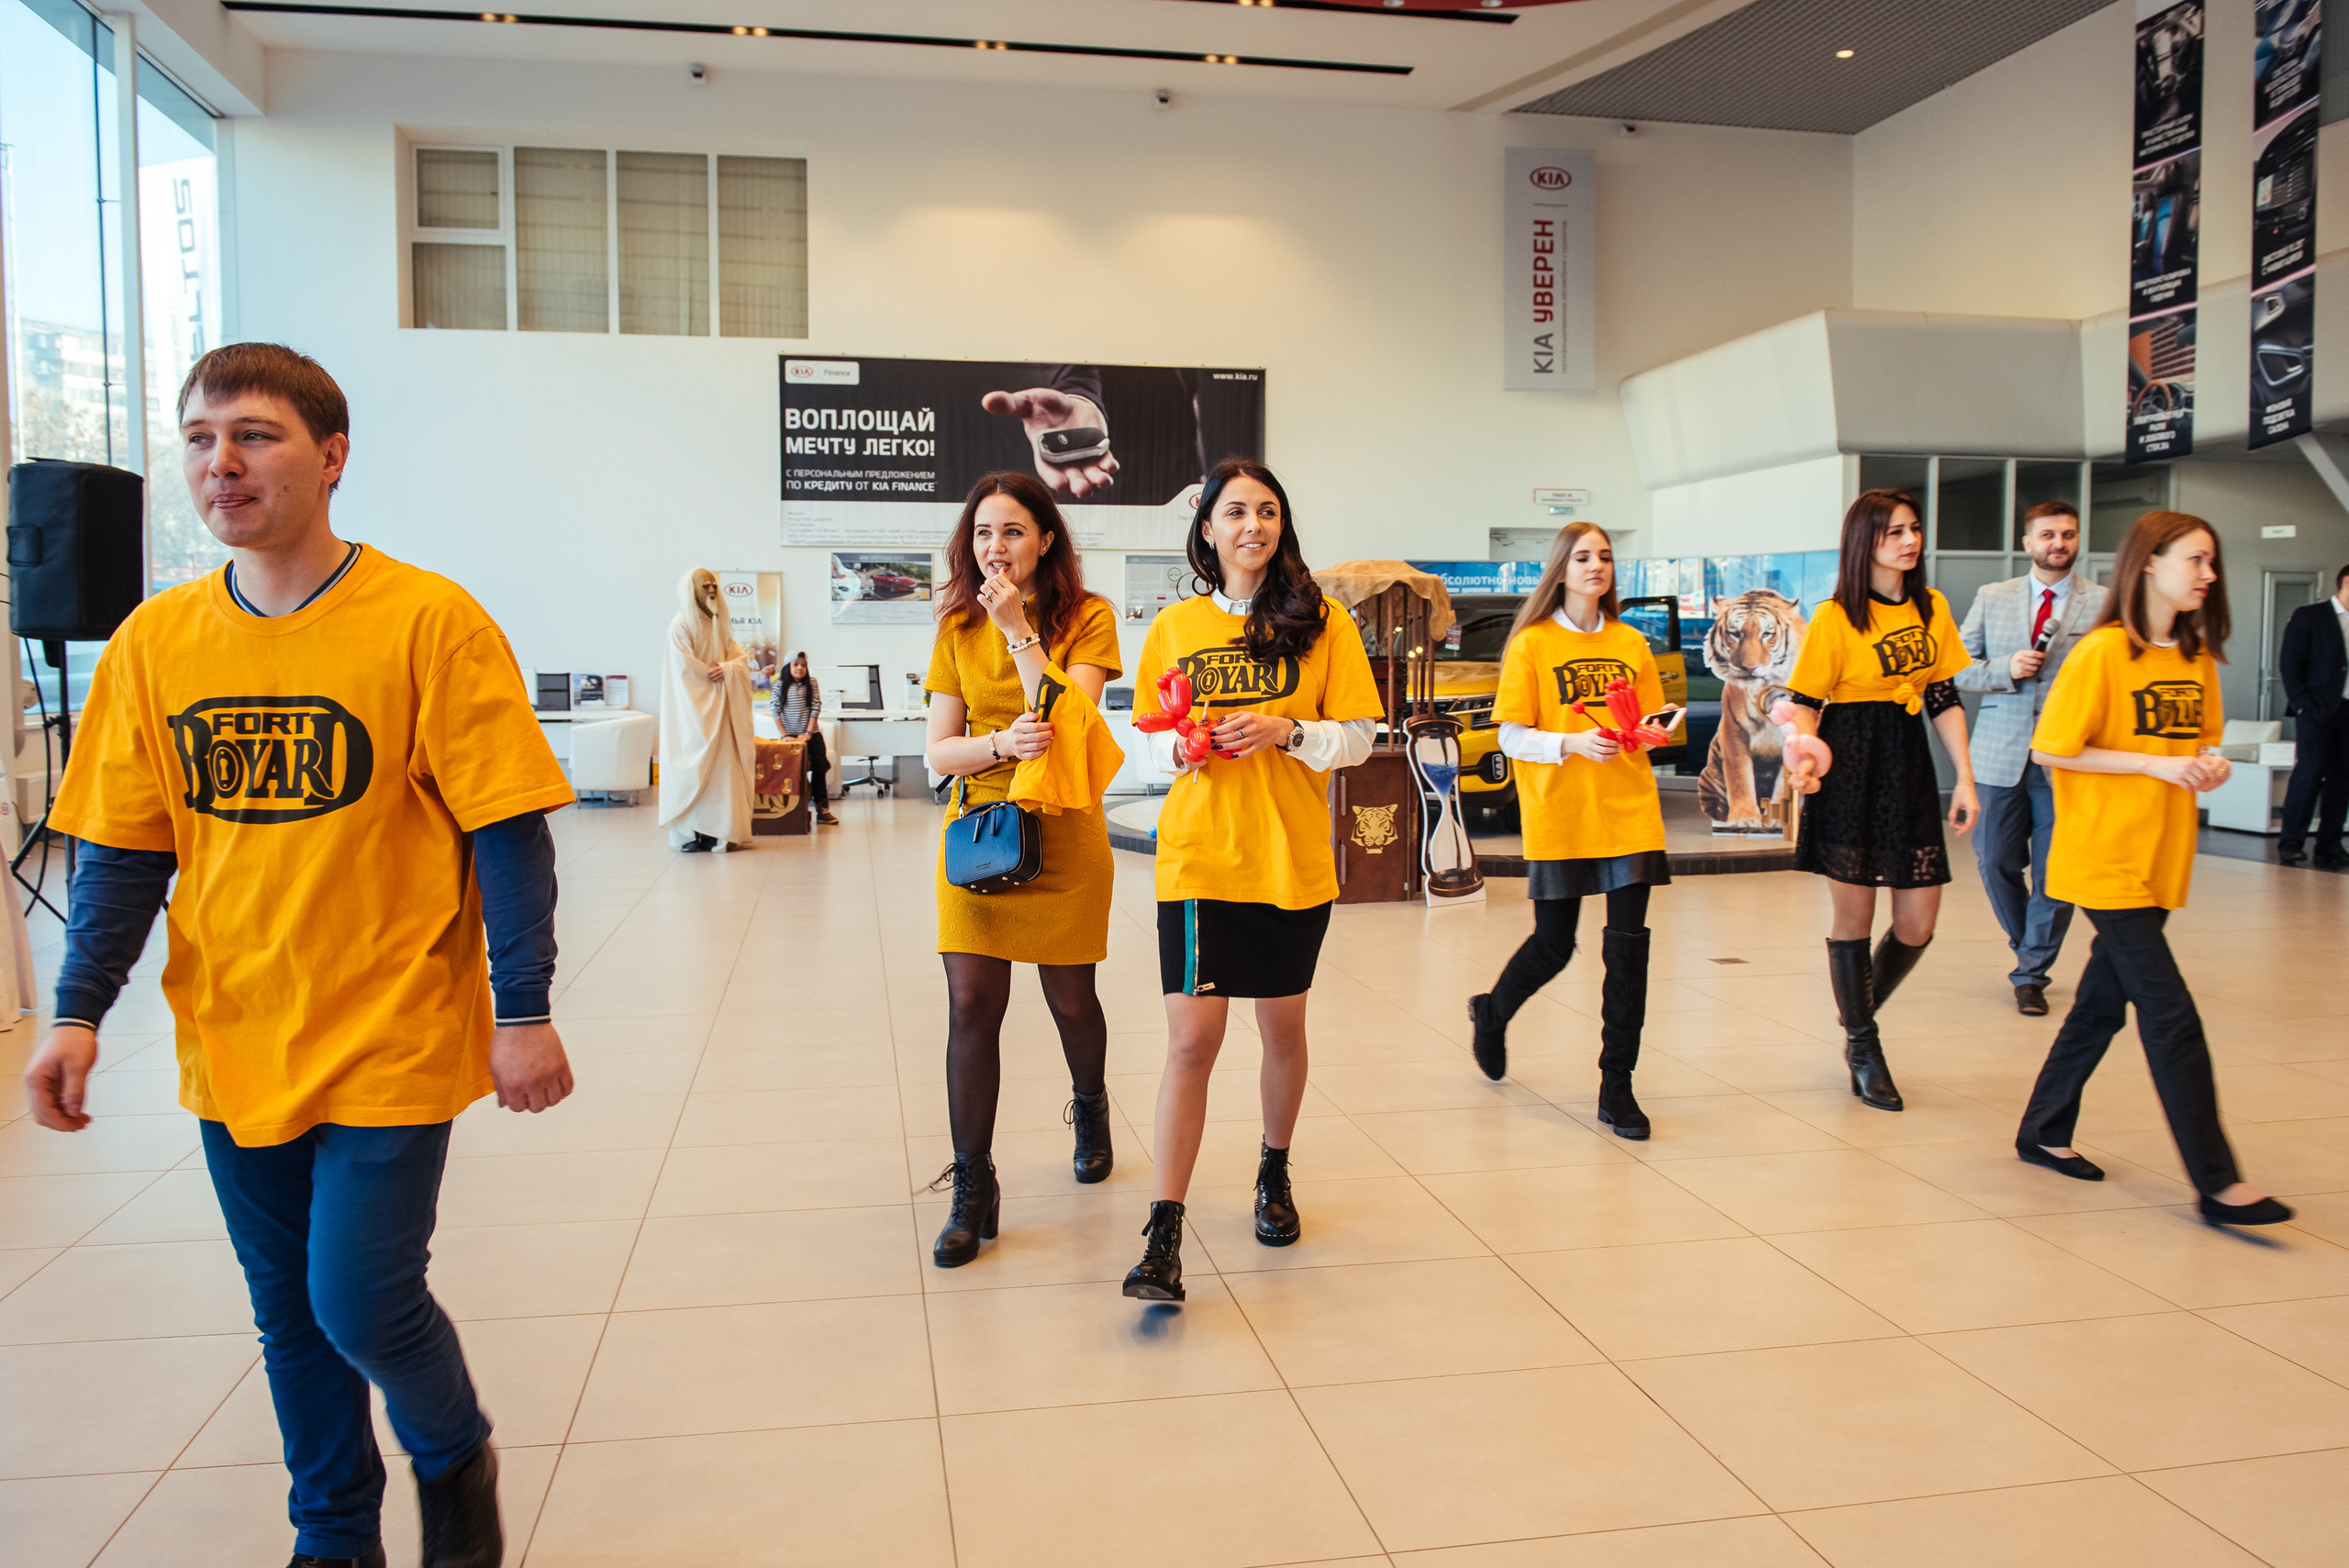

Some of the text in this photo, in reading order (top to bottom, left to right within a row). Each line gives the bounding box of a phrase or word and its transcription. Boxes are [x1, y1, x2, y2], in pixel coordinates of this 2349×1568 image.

[1537, 172, 1564, 184] KIA
[172, 177, 206, 361] ELTOS
[1533, 219, 1553, 373] KIA УВЕРЕН
[1212, 372, 1258, 381] www.kia.ru
[785, 407, 935, 436] ВОПЛОЩАЙ
[785, 437, 935, 457] МЕЧТУ ЛЕГКО!
[785, 469, 935, 480] С ПЕРСОНАЛЬНЫМ ПРЕДЛОЖЕНИЕМ
[785, 480, 935, 492] ПО КРЕДИТУ ОТ KIA FINANCE
[1440, 573, 1542, 585] бсолютно новы
[729, 585, 748, 594] KIA
[1206, 653, 1254, 665] FOR
[1576, 664, 1613, 673] FORT
[212, 712, 311, 736] FORT
[167, 708, 373, 820] BOYARD
